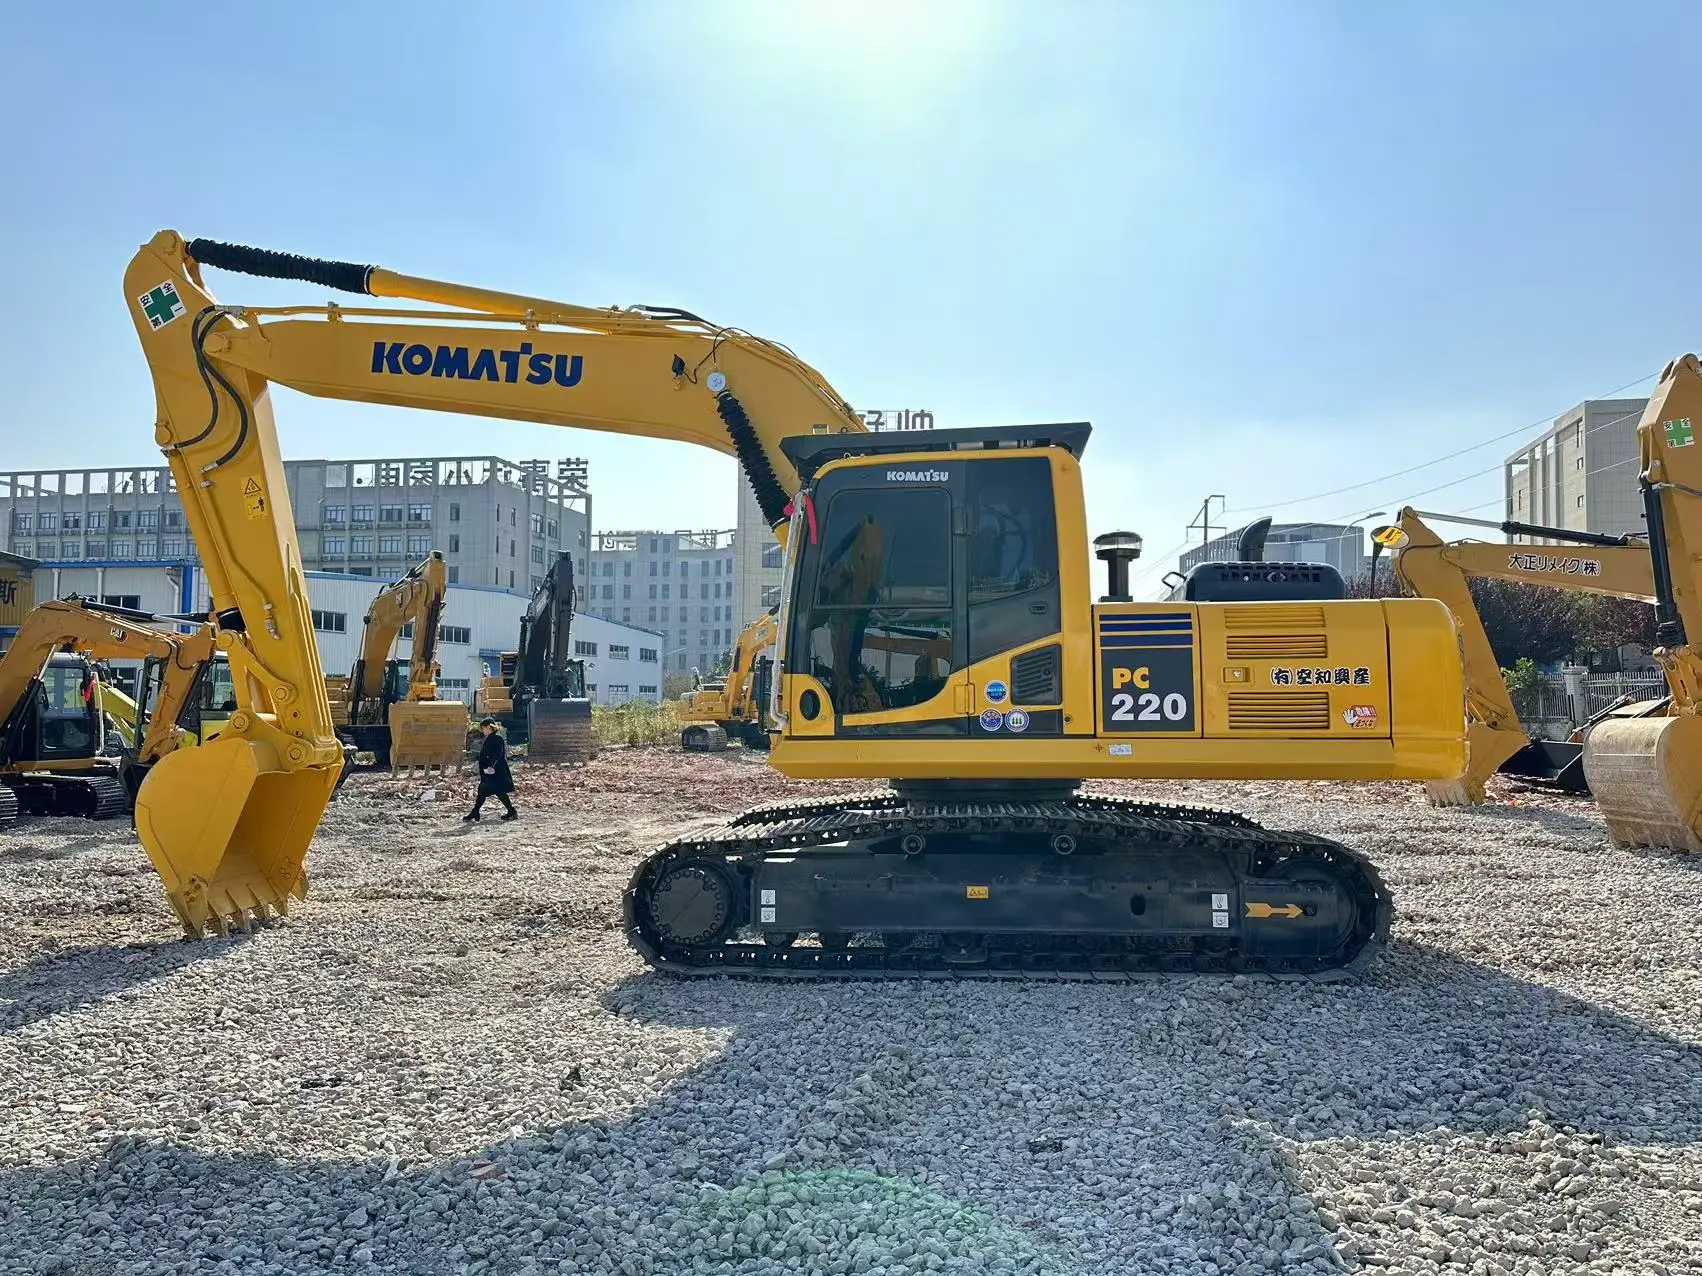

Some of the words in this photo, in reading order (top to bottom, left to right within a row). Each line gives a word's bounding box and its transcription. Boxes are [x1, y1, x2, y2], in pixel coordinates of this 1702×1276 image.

[371, 341, 583, 388] KOMATSU
[886, 469, 949, 482] KOMATSU
[1112, 667, 1150, 689] PC
[1111, 693, 1187, 721] 220
